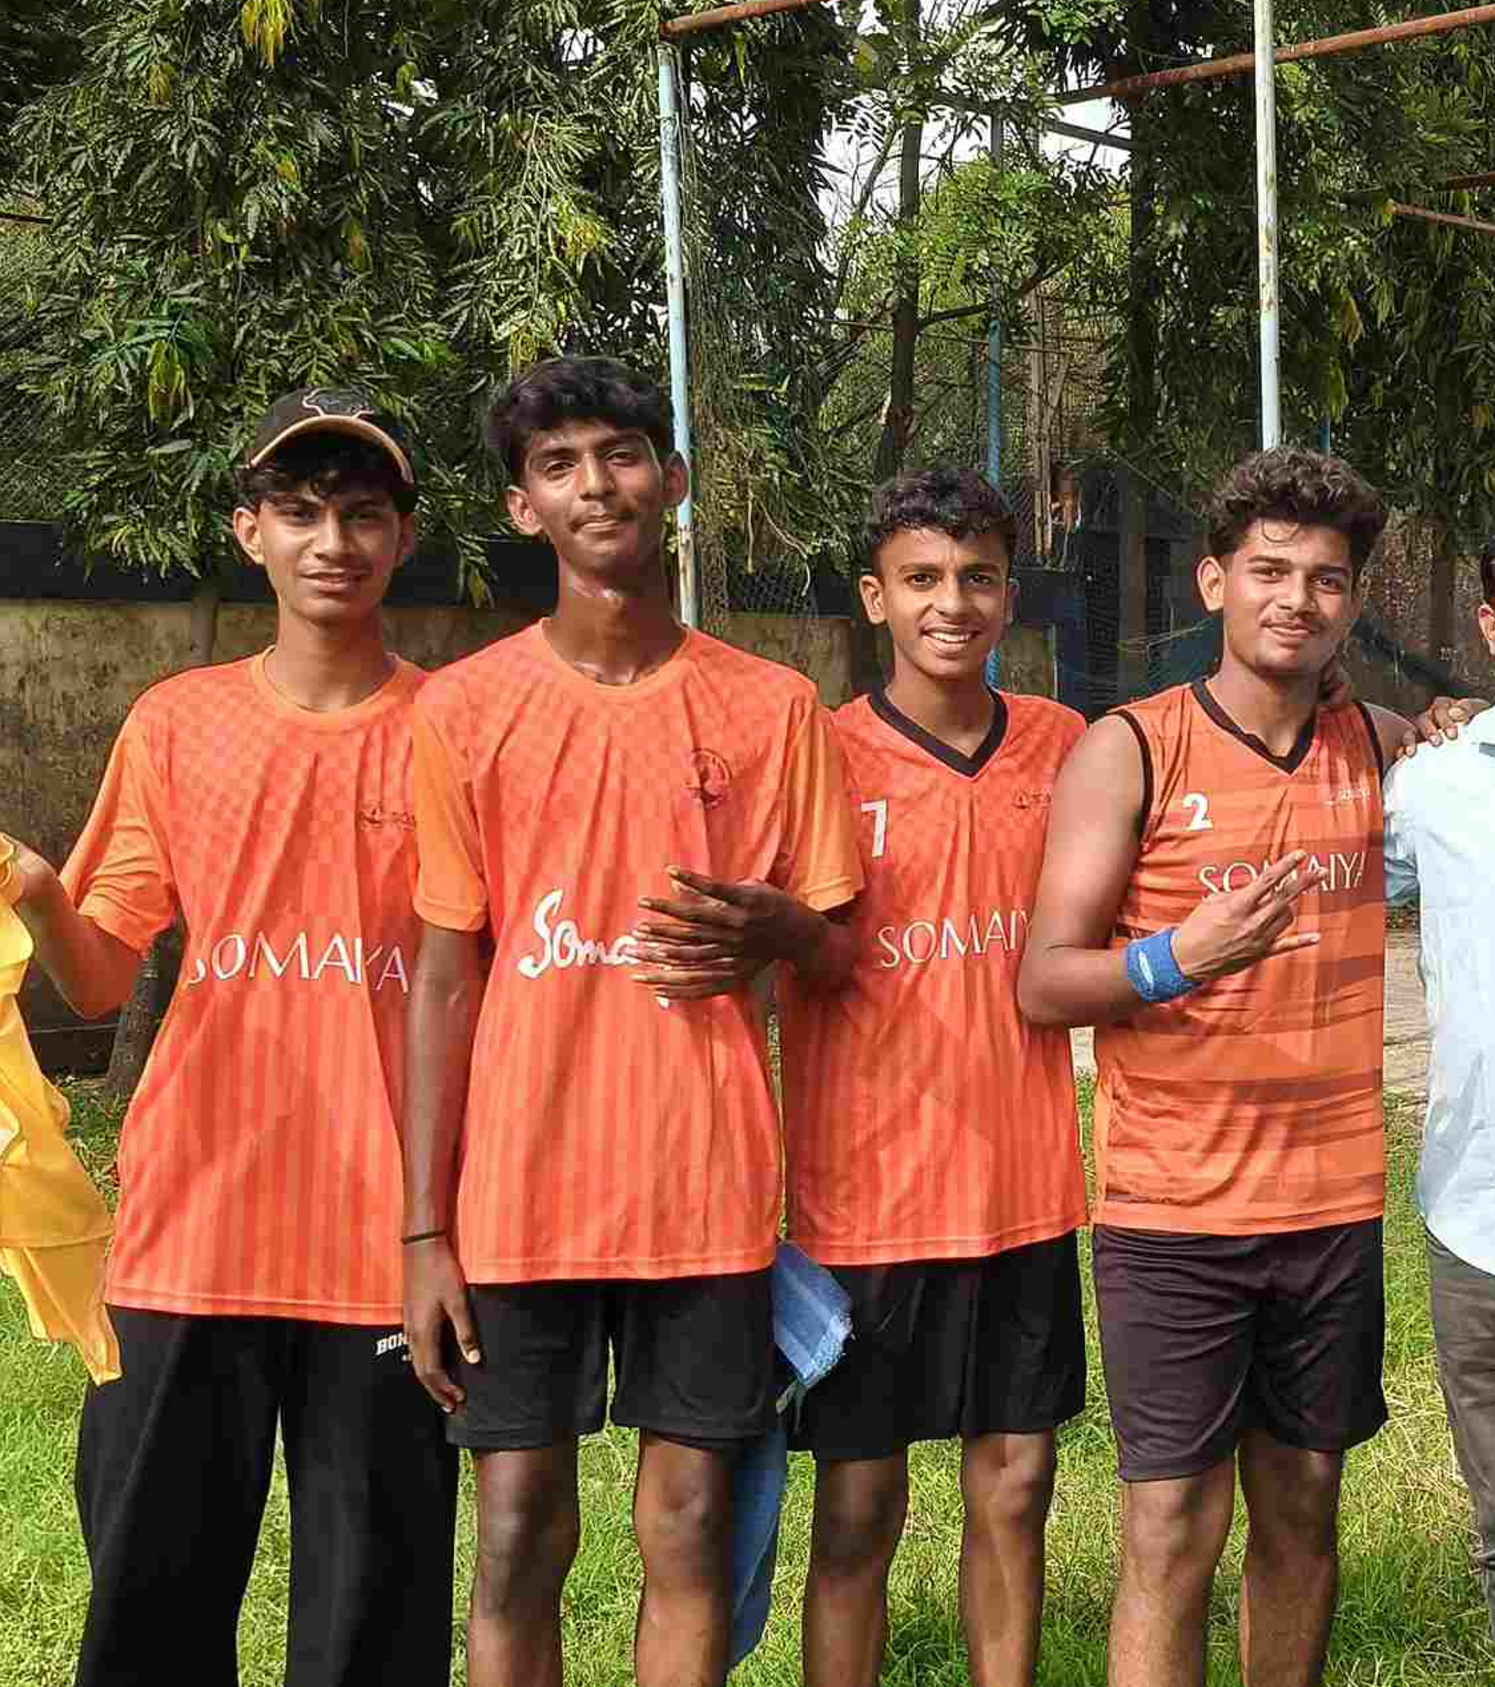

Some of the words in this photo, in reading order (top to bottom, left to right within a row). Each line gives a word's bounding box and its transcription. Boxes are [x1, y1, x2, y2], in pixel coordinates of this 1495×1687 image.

[860, 799, 887, 858] 7
[1182, 792, 1213, 832] 2
[877, 910, 1032, 968] SOMAIY
